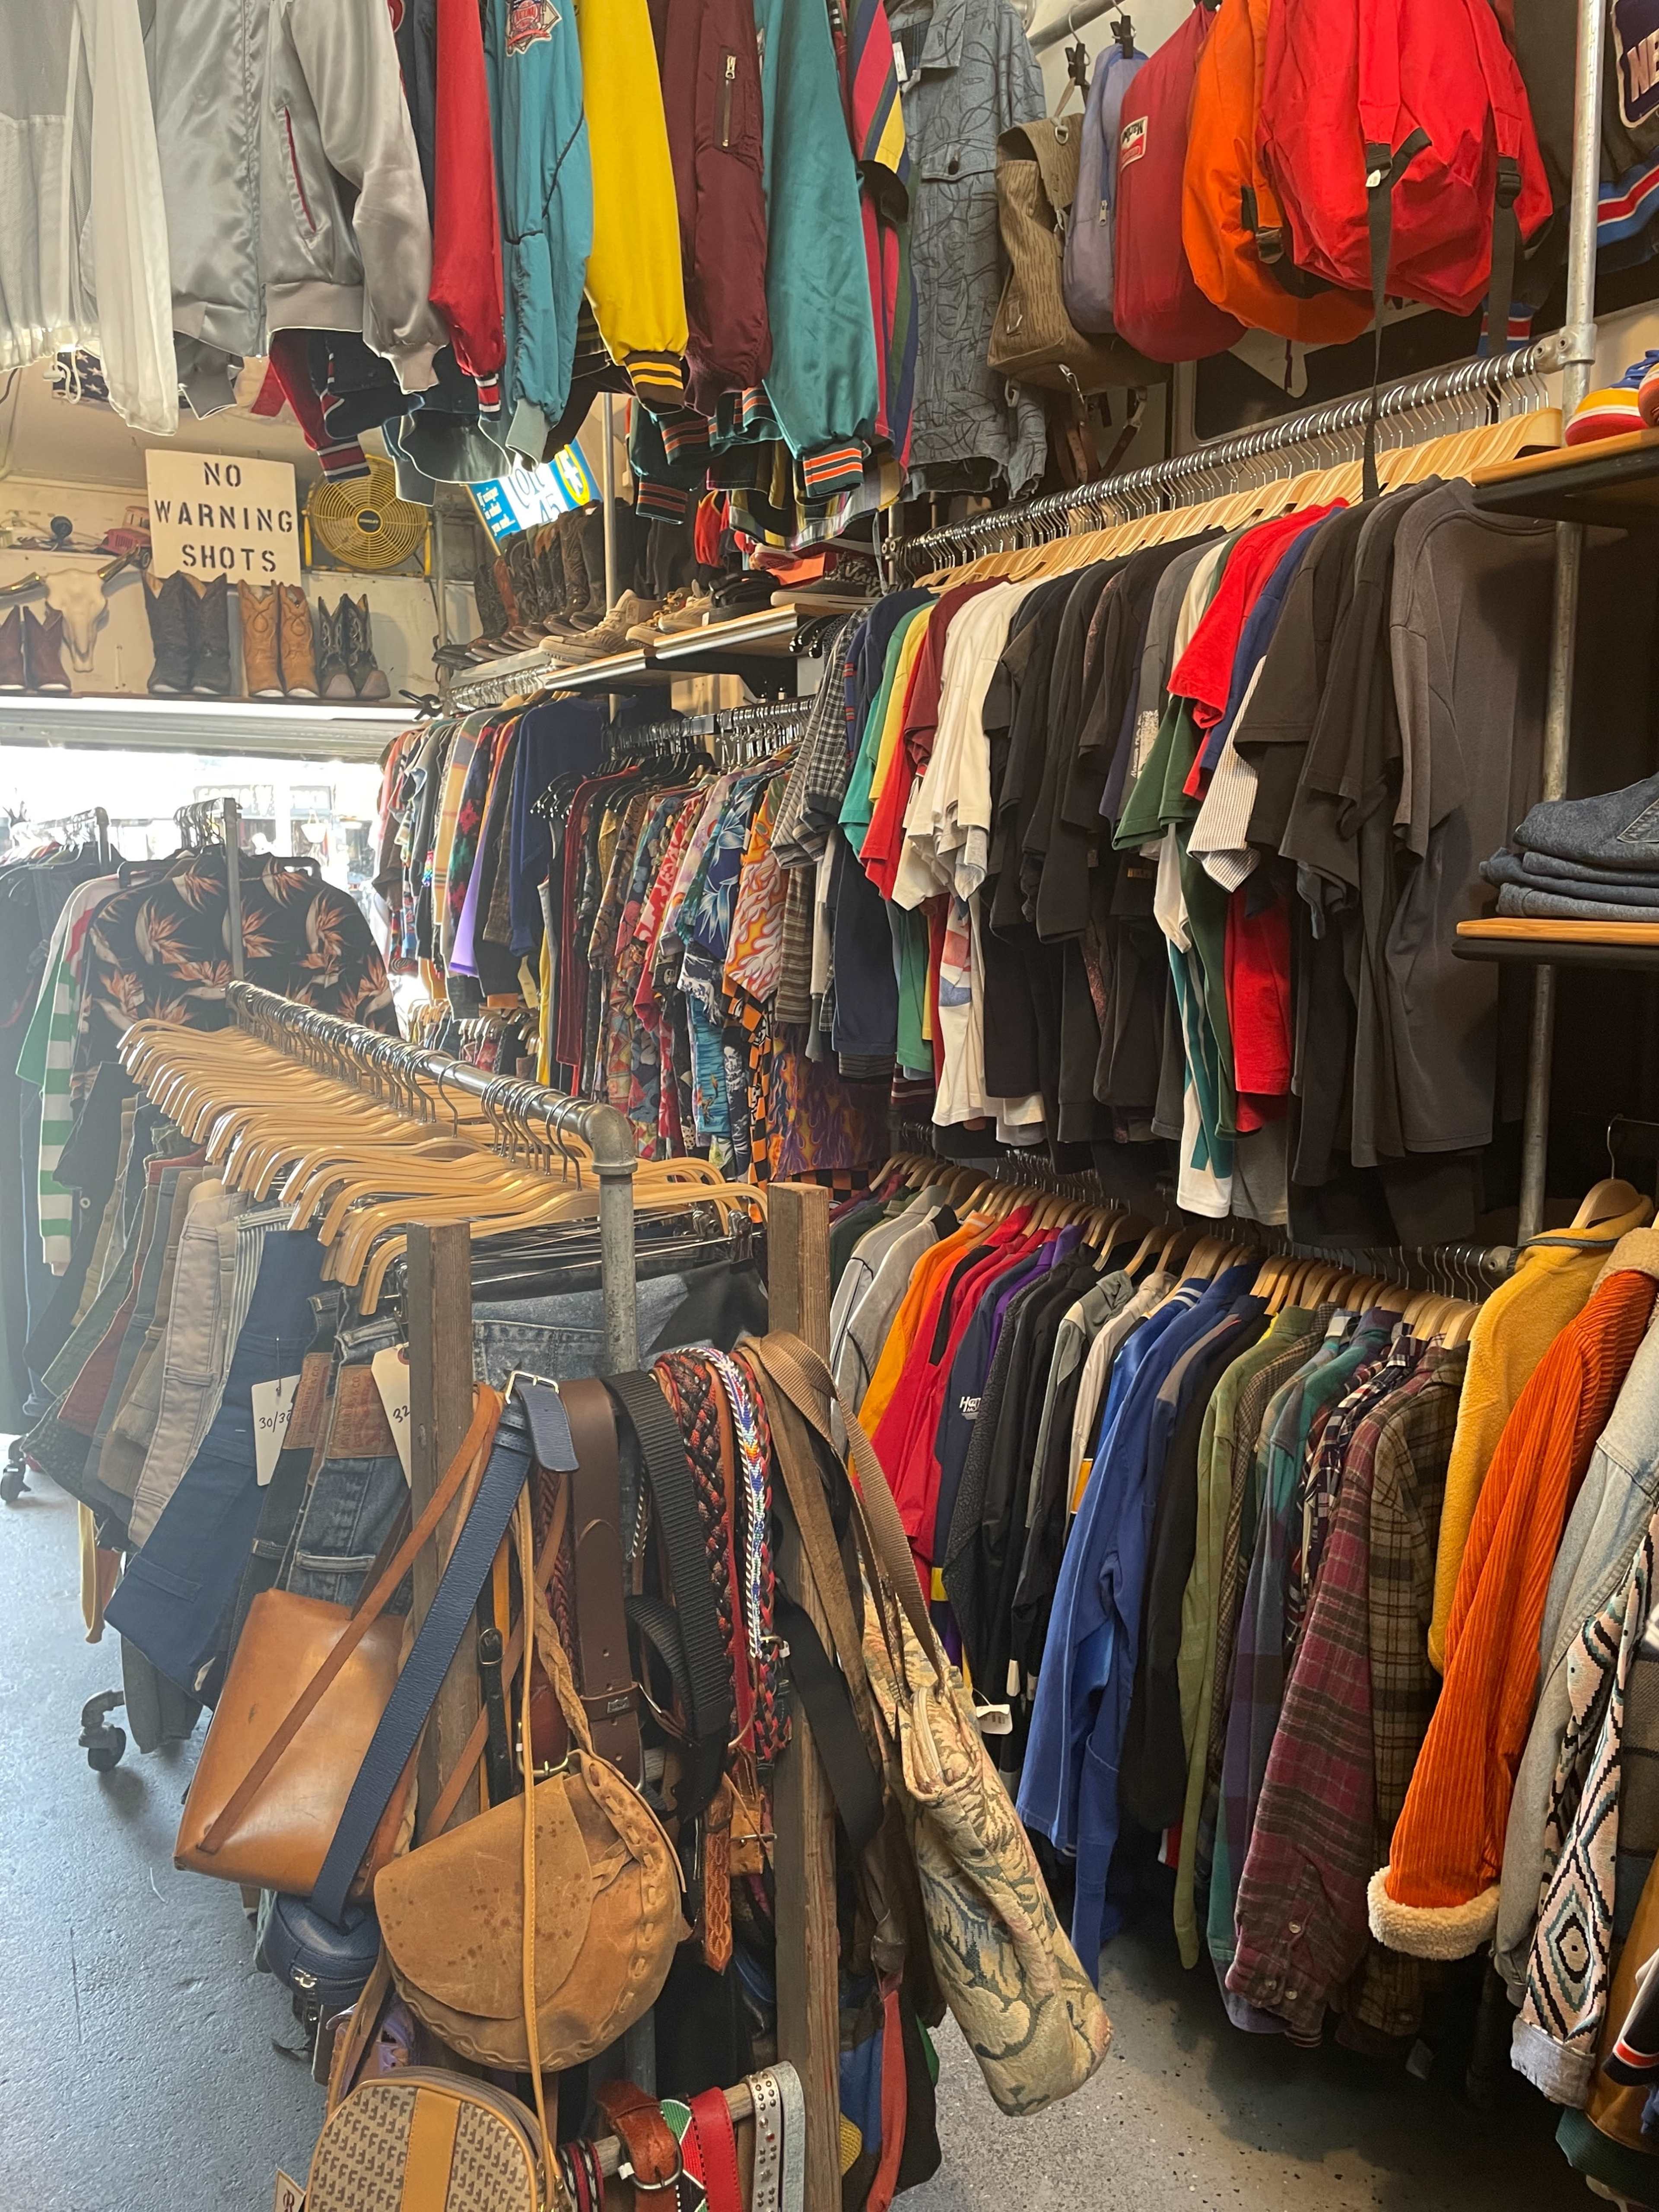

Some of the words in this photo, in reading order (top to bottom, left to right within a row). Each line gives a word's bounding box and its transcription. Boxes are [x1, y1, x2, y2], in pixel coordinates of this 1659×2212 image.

[204, 462, 241, 487] NO
[155, 500, 292, 532] WARNING
[182, 544, 276, 572] SHOTS
[393, 1405, 411, 1423] 32
